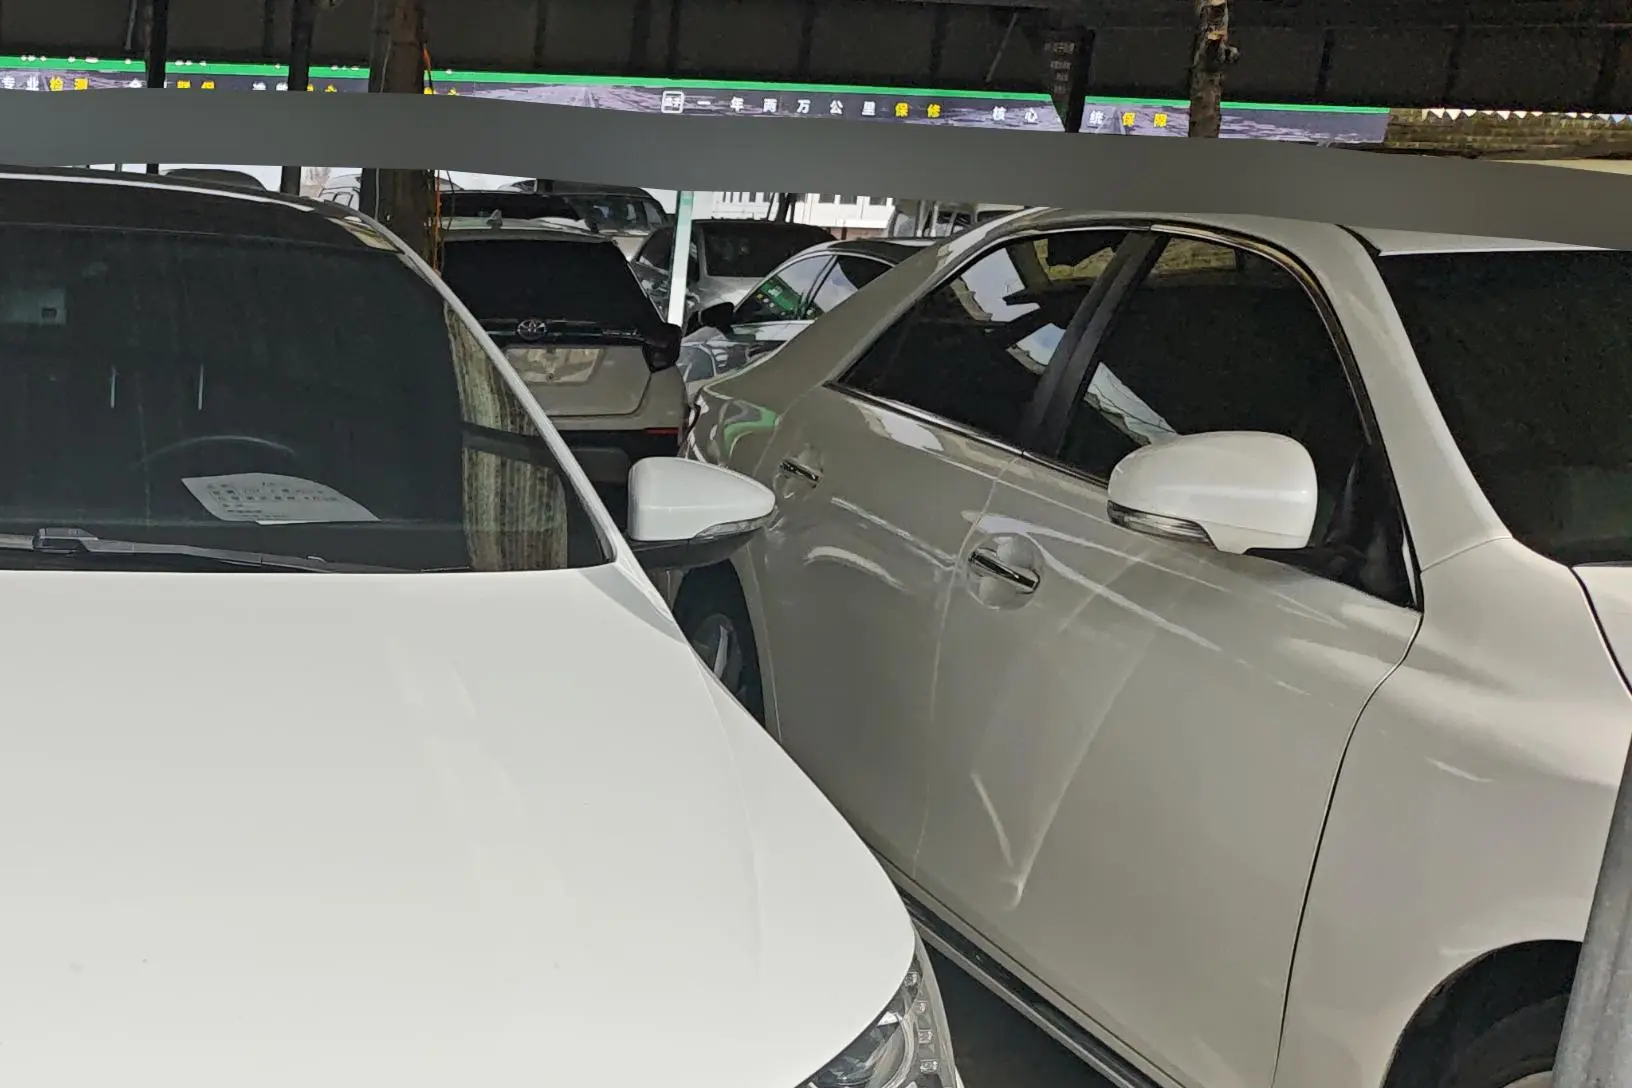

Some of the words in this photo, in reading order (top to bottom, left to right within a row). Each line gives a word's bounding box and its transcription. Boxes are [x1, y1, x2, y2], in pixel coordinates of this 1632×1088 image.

[696, 96, 941, 119] 一年两万公里保修
